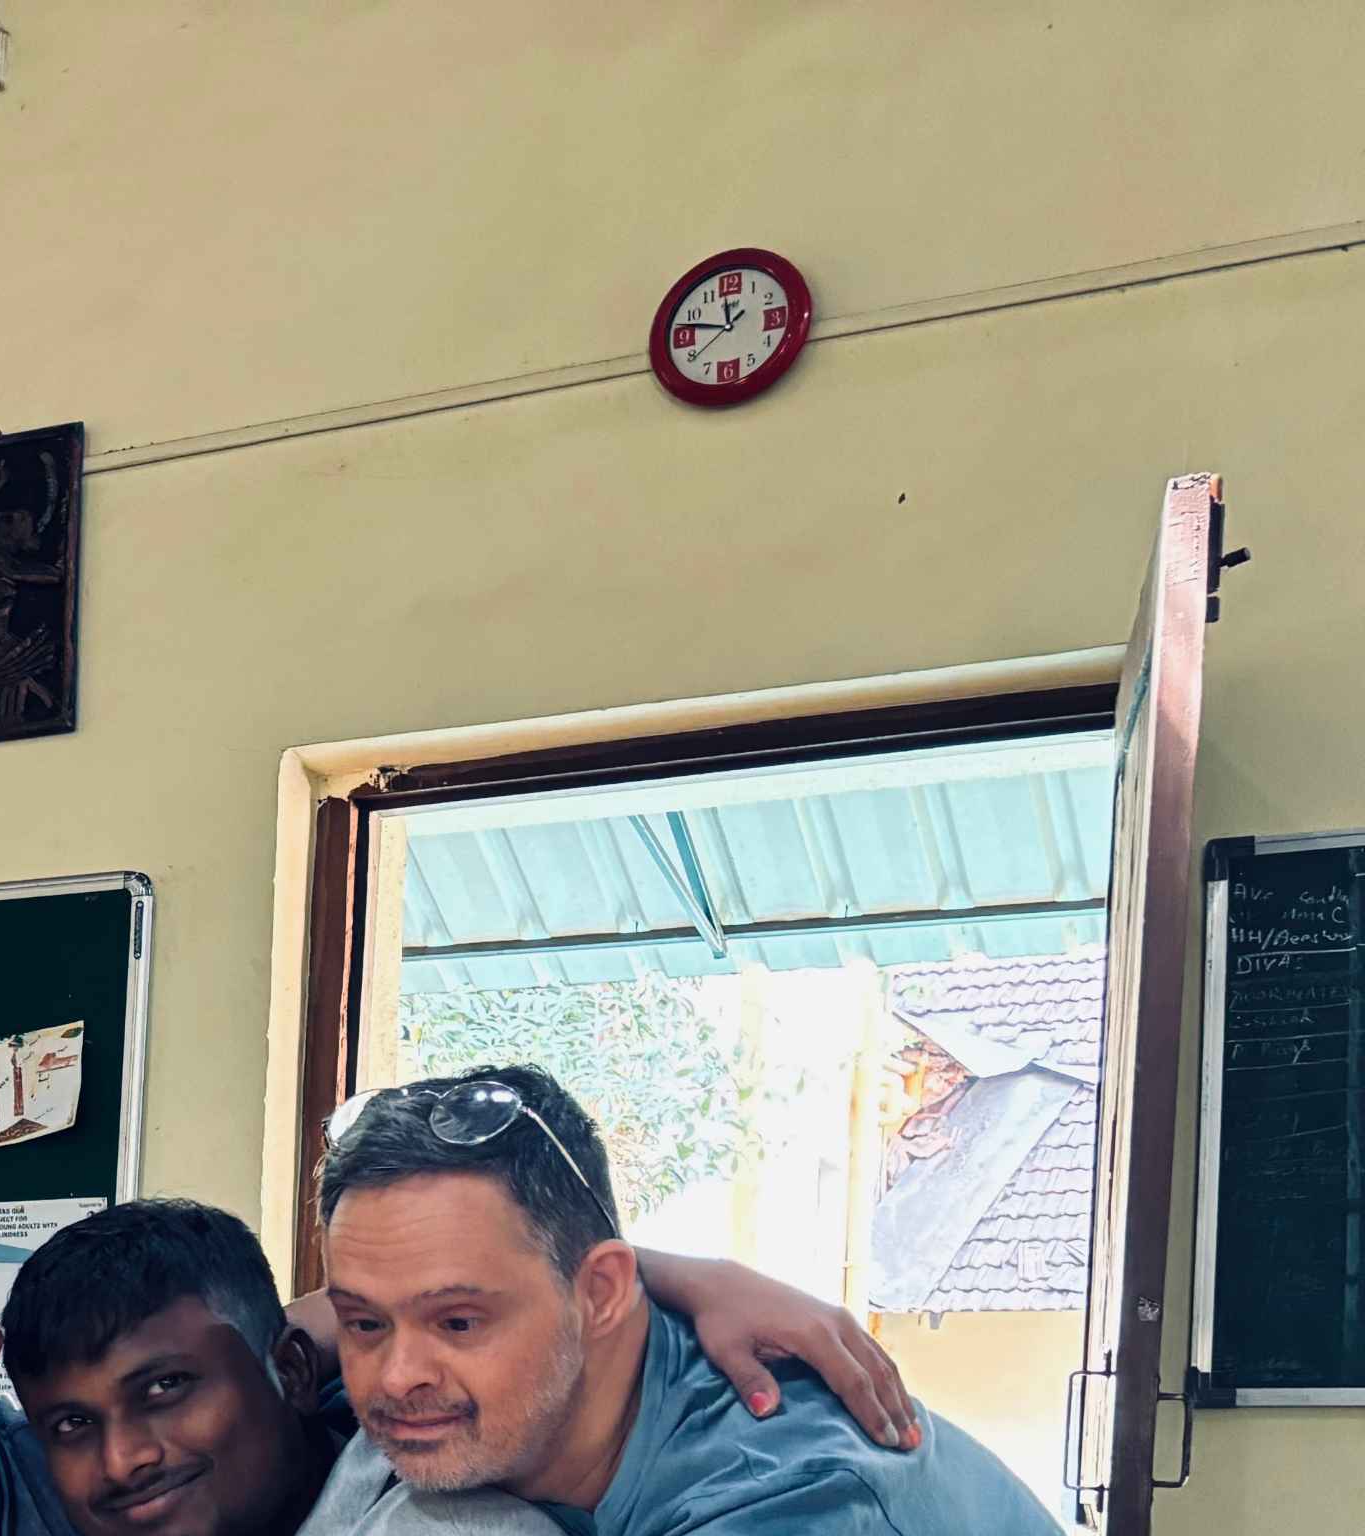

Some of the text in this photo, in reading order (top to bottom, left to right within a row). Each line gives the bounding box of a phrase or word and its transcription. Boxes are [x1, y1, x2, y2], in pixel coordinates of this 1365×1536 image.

[722, 274, 739, 293] 12
[751, 281, 756, 294] 1
[703, 290, 715, 304] 11
[764, 292, 773, 306] 2
[686, 308, 701, 322] 10
[770, 311, 781, 326] 3
[678, 330, 690, 345] 9
[763, 335, 771, 347] 4
[687, 350, 696, 362] 8
[746, 353, 756, 367] 5
[703, 362, 712, 375] 7
[723, 364, 734, 379] 6
